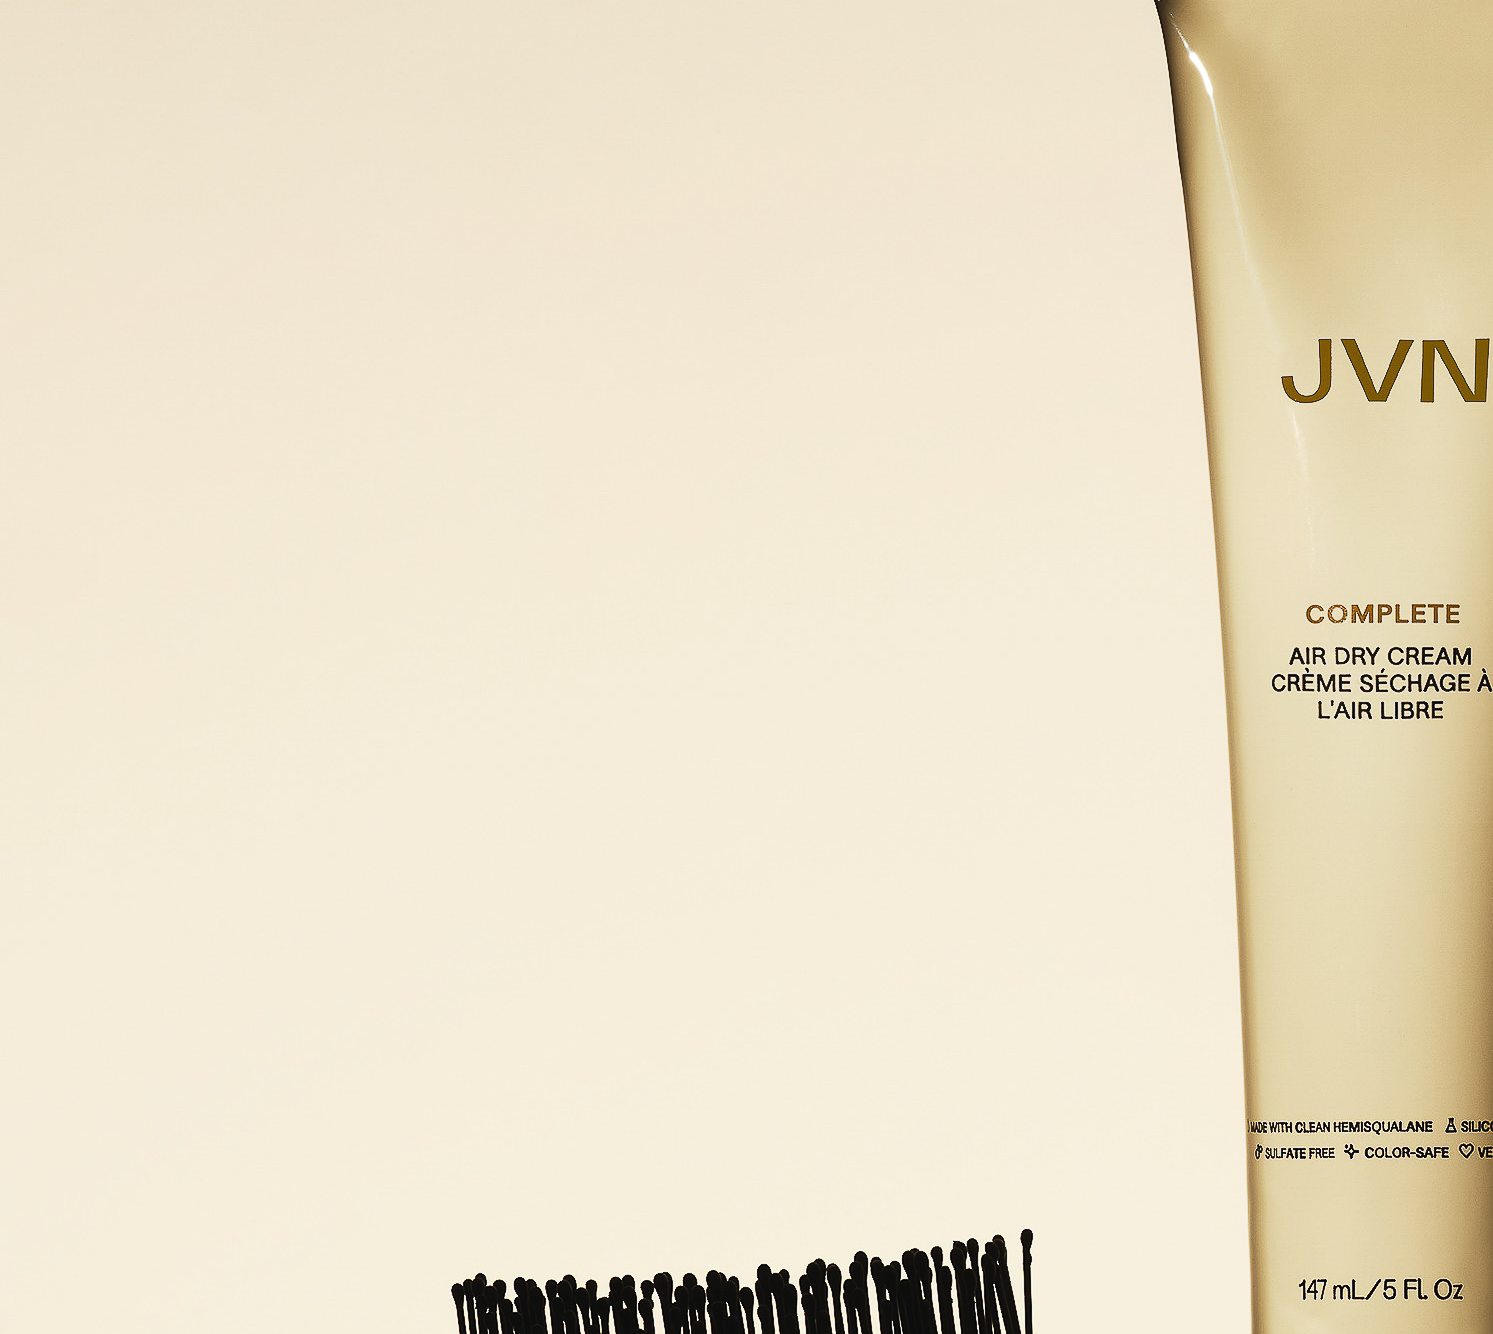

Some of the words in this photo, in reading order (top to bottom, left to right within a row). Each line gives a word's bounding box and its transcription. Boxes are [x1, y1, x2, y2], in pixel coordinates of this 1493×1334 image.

[1281, 338, 1490, 404] JVN
[1305, 604, 1461, 624] COMPLETE
[1289, 647, 1326, 666] AIR
[1335, 646, 1380, 666] DRY
[1388, 646, 1472, 666] CREAM
[1271, 669, 1352, 693] CRÈME
[1360, 669, 1470, 693] SÉCHAGE
[1476, 669, 1493, 692] À
[1317, 700, 1373, 720] L'AIR
[1380, 701, 1444, 720] LIBRE
[1269, 1121, 1293, 1133] WITH
[1295, 1121, 1331, 1133] CLEAN
[1333, 1120, 1434, 1135] HEMISQUALANE
[1265, 1147, 1307, 1159] SULFATE
[1308, 1147, 1336, 1159] FREE
[1364, 1146, 1450, 1159] COLOR-SAFE
[1298, 1278, 1328, 1300] 147
[1433, 1278, 1464, 1301] Oz
